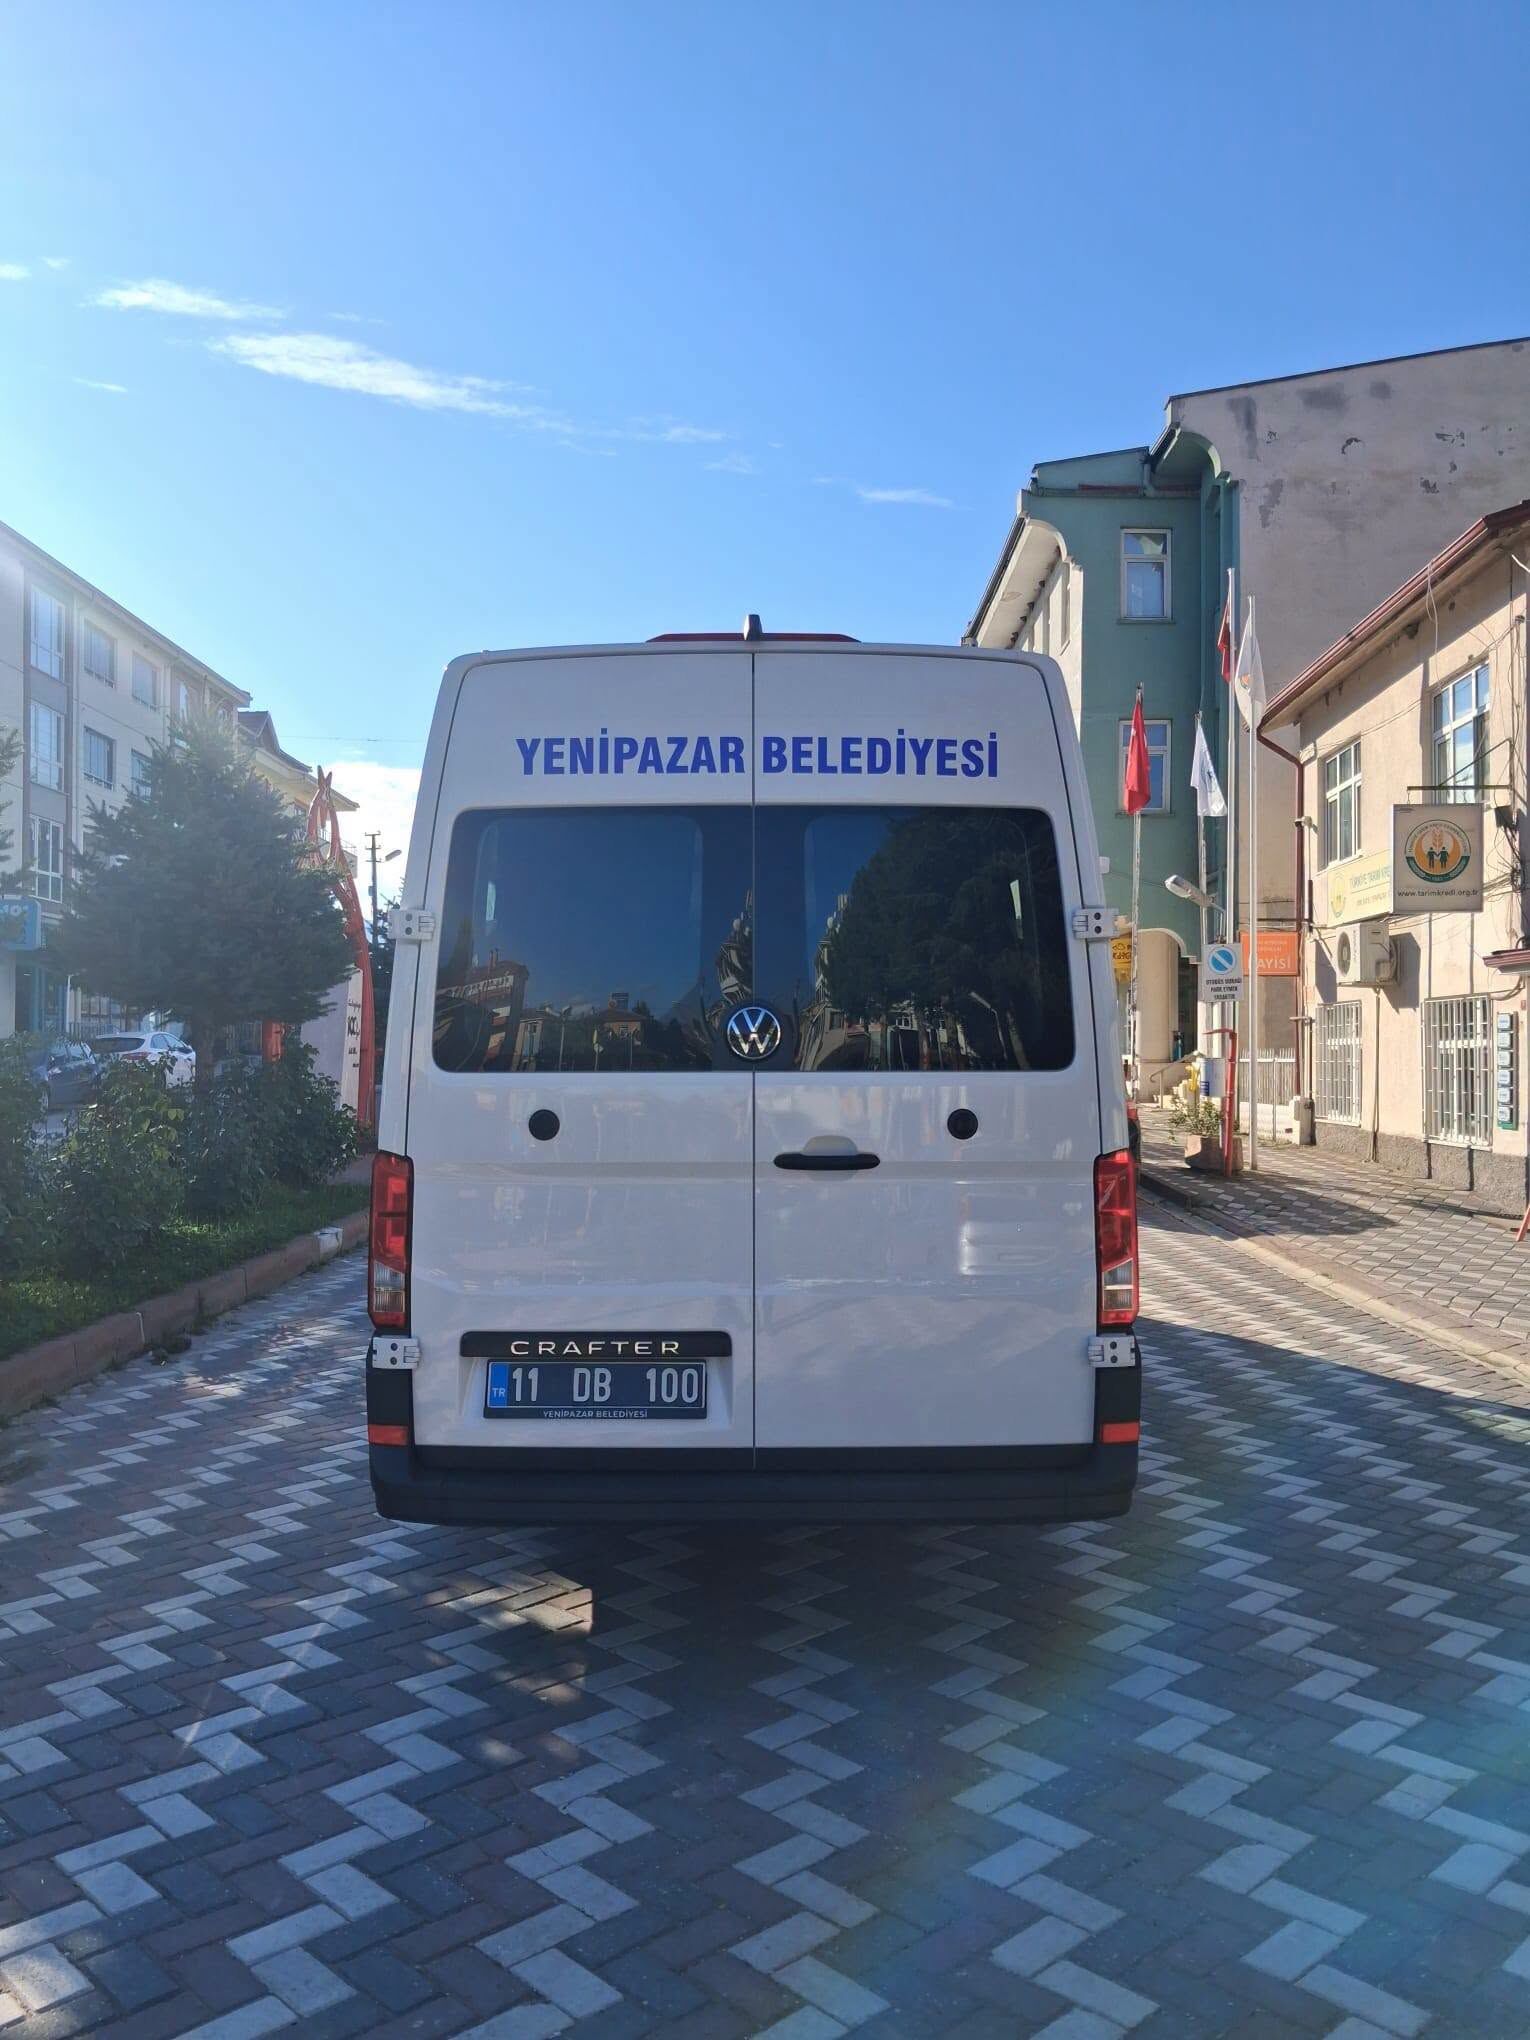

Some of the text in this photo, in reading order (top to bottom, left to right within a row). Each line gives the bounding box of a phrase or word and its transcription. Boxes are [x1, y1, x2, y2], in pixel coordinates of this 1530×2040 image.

[515, 727, 999, 778] YENİPAZAR BELEDİYESİ
[510, 1340, 680, 1355] CRAFTER
[492, 1367, 699, 1403] TR 11 DB 100
[543, 1409, 648, 1418] YENİPAZAR BELEDİYESİ
